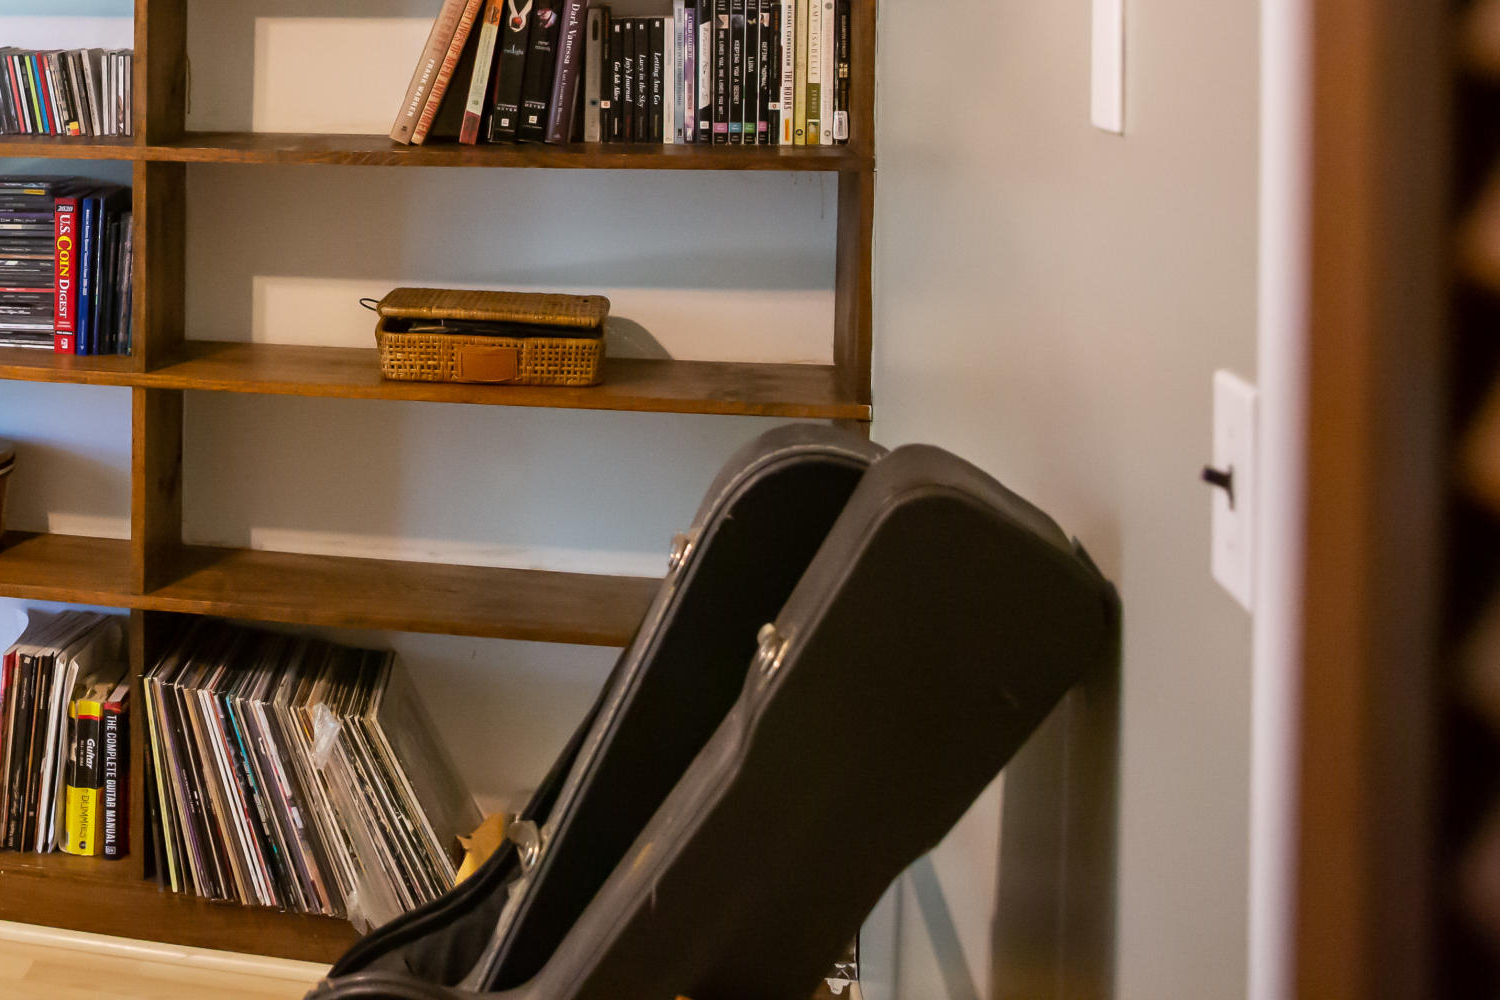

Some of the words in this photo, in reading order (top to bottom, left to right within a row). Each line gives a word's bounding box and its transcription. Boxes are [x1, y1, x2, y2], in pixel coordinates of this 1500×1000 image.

[569, 3, 580, 26] Dark
[811, 4, 820, 18] AMY
[453, 22, 472, 42] LIVES
[450, 43, 463, 54] OF
[563, 29, 576, 64] Vanessa
[811, 32, 819, 76] ISABELLE
[420, 58, 435, 84] FRANK
[440, 57, 458, 77] MEN
[614, 61, 620, 71] Go
[637, 54, 645, 71] Lucy
[652, 53, 661, 77] Letting
[431, 78, 449, 98] AND
[784, 71, 792, 83] THE
[407, 85, 425, 118] WARREN
[637, 94, 645, 108] Sky
[653, 94, 660, 105] Go
[784, 86, 792, 110] HOURS
[416, 99, 441, 137] WOMEN
[56, 204, 74, 212] 2020
[59, 214, 70, 235] U.S.
[56, 235, 72, 277] COIN
[59, 279, 70, 318] DIGEST
[106, 715, 117, 731] THE
[85, 738, 96, 768] Guitar
[106, 732, 117, 777] COMPLETE
[106, 779, 117, 807] GUITAR
[79, 794, 90, 838] DUMMIES
[106, 809, 117, 844] MANUAL
